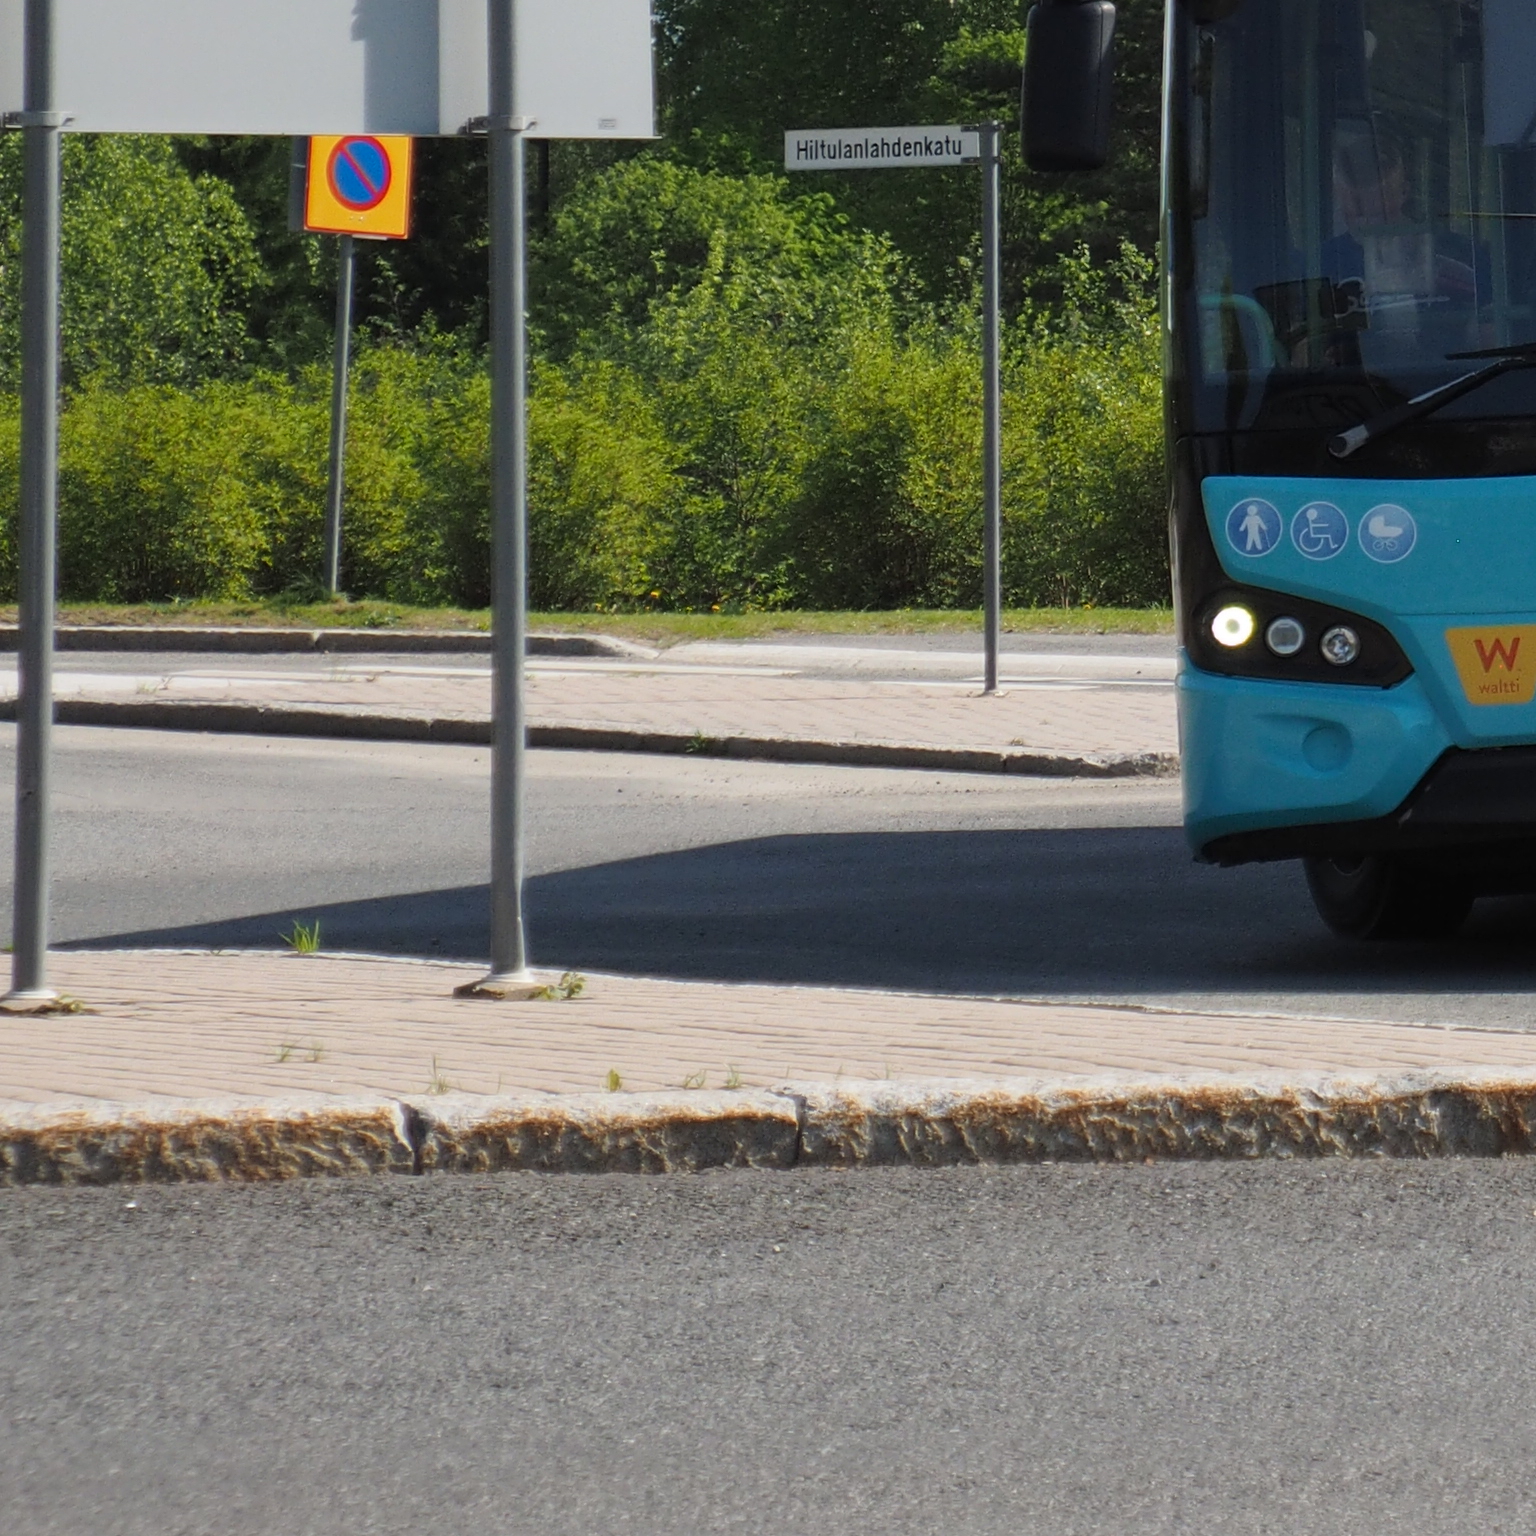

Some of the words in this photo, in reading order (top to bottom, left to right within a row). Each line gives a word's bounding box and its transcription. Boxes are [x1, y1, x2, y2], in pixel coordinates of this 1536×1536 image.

[796, 135, 962, 161] Hiltulanlahdenkatu
[1474, 637, 1520, 673] W
[1478, 678, 1520, 694] waltti
